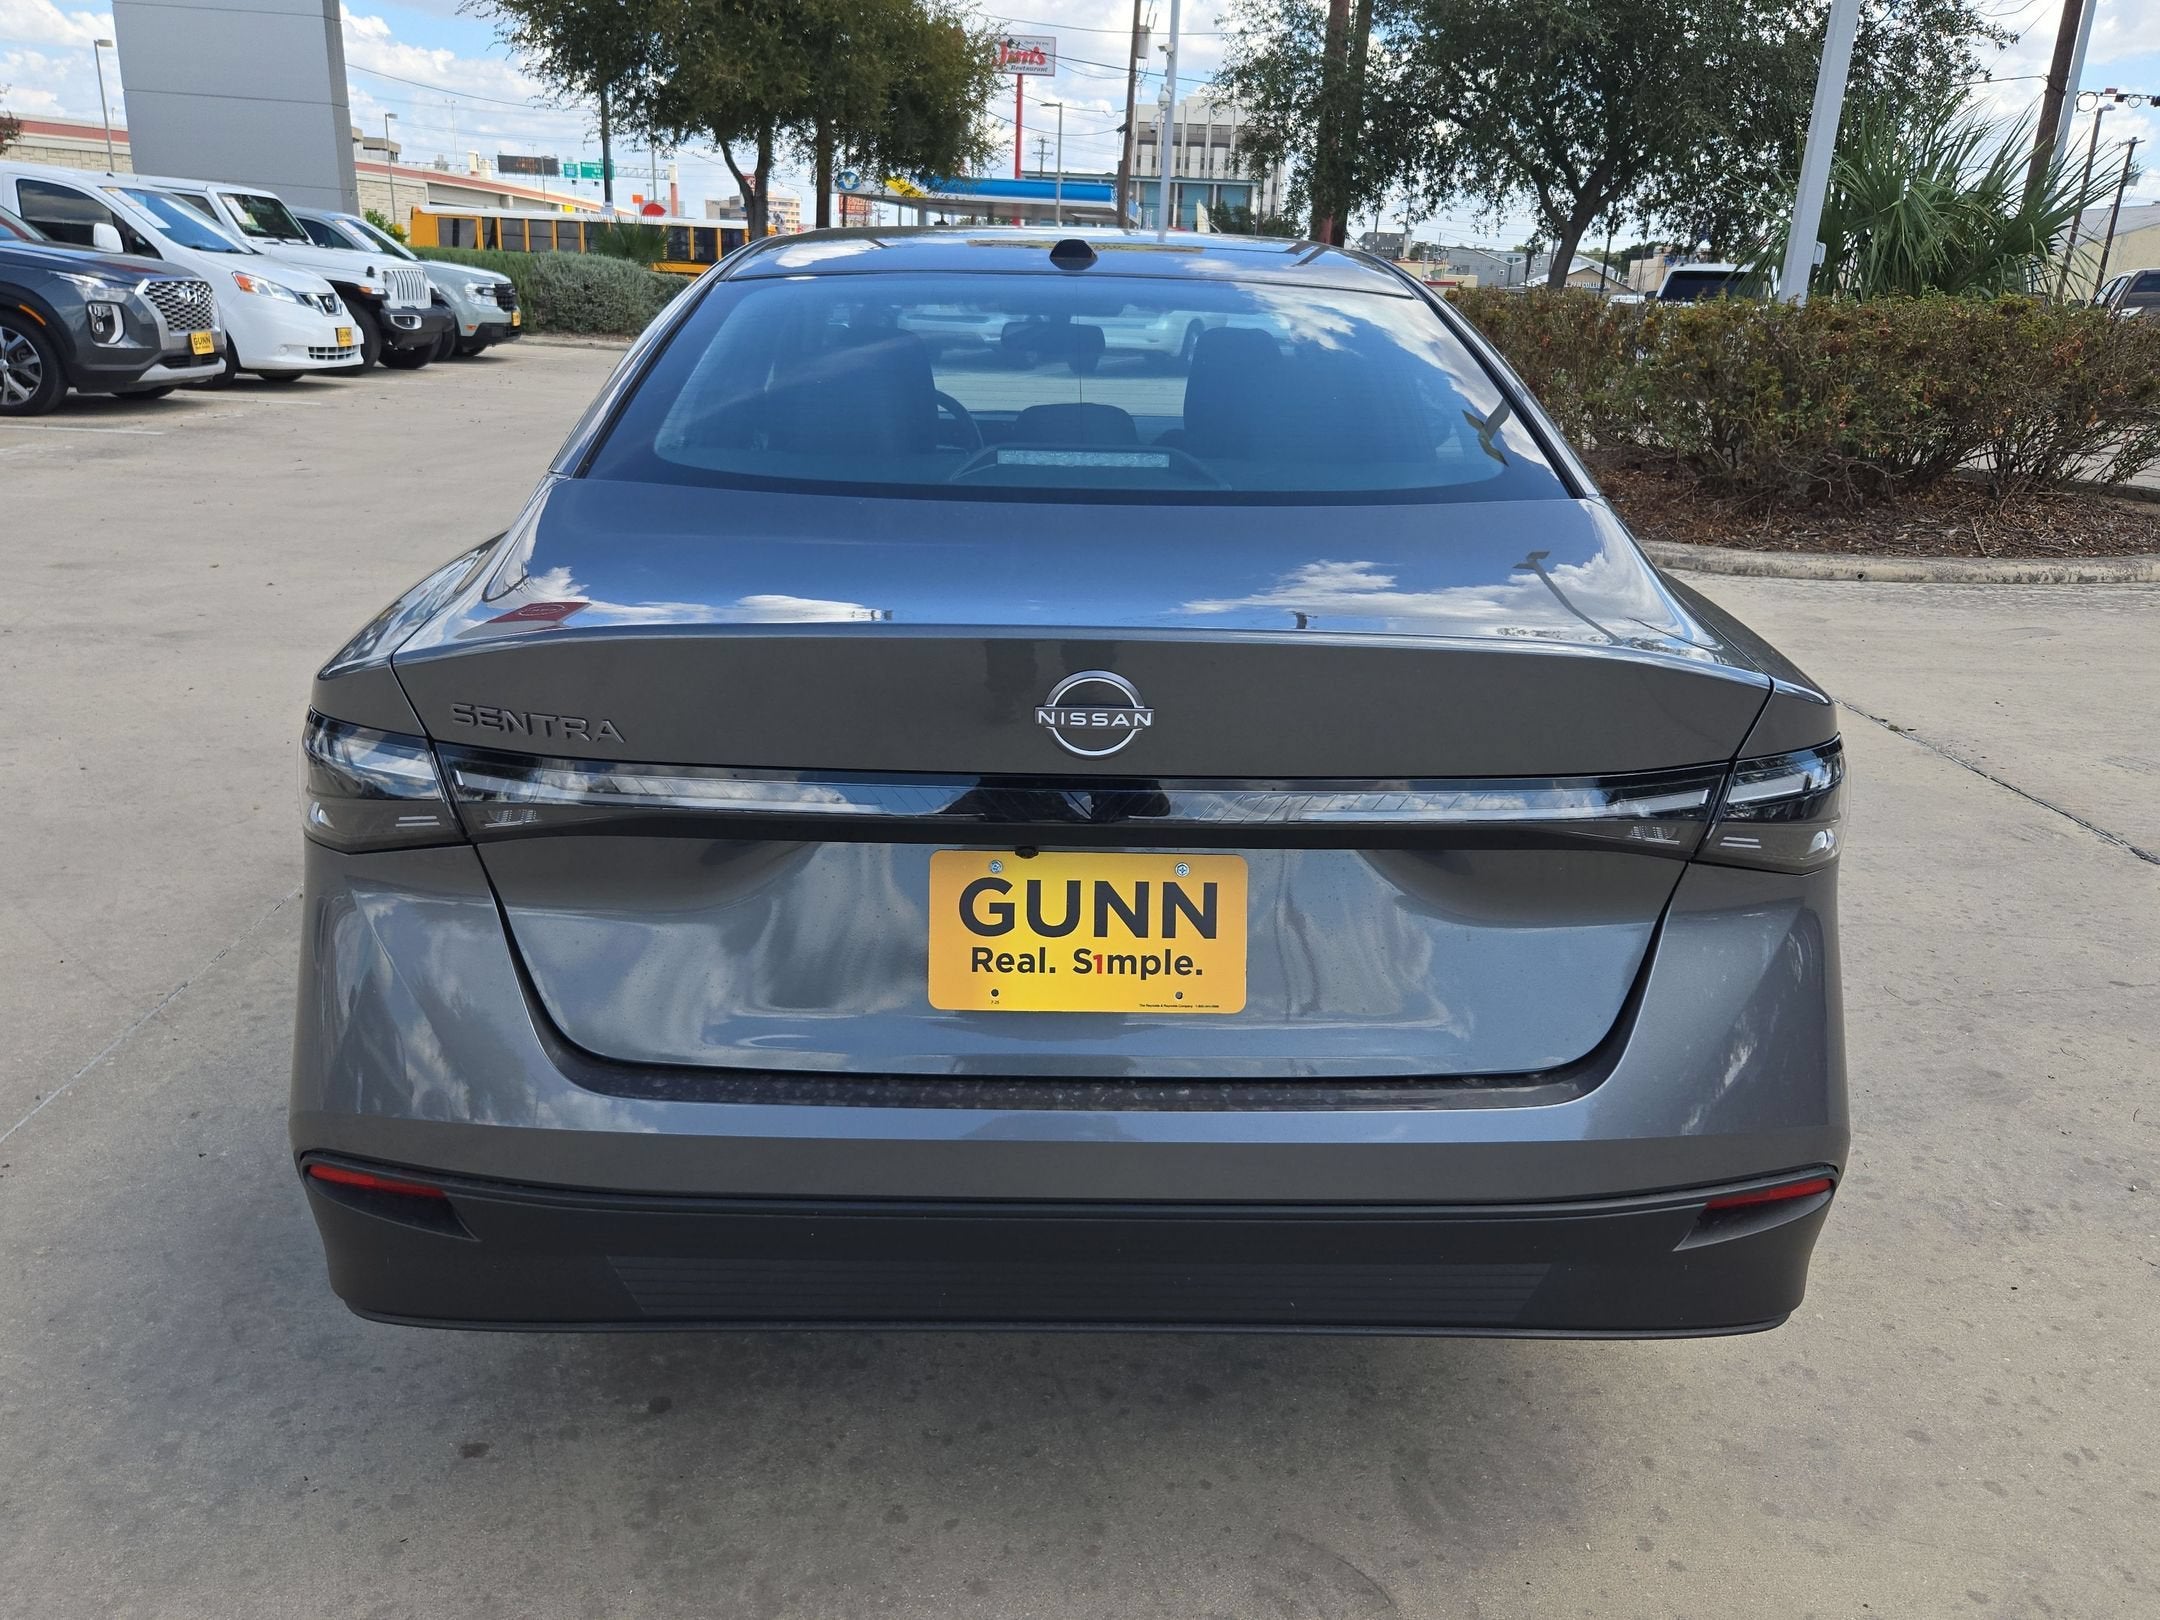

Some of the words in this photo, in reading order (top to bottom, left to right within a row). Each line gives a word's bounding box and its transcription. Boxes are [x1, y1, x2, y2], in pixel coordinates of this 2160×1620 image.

[1583, 281, 1611, 289] COLLISON
[193, 336, 211, 345] GUNN
[451, 702, 626, 744] SENTRA
[1038, 710, 1152, 727] NISSAN
[958, 877, 1218, 940] GUNN
[971, 947, 1056, 974] Real.
